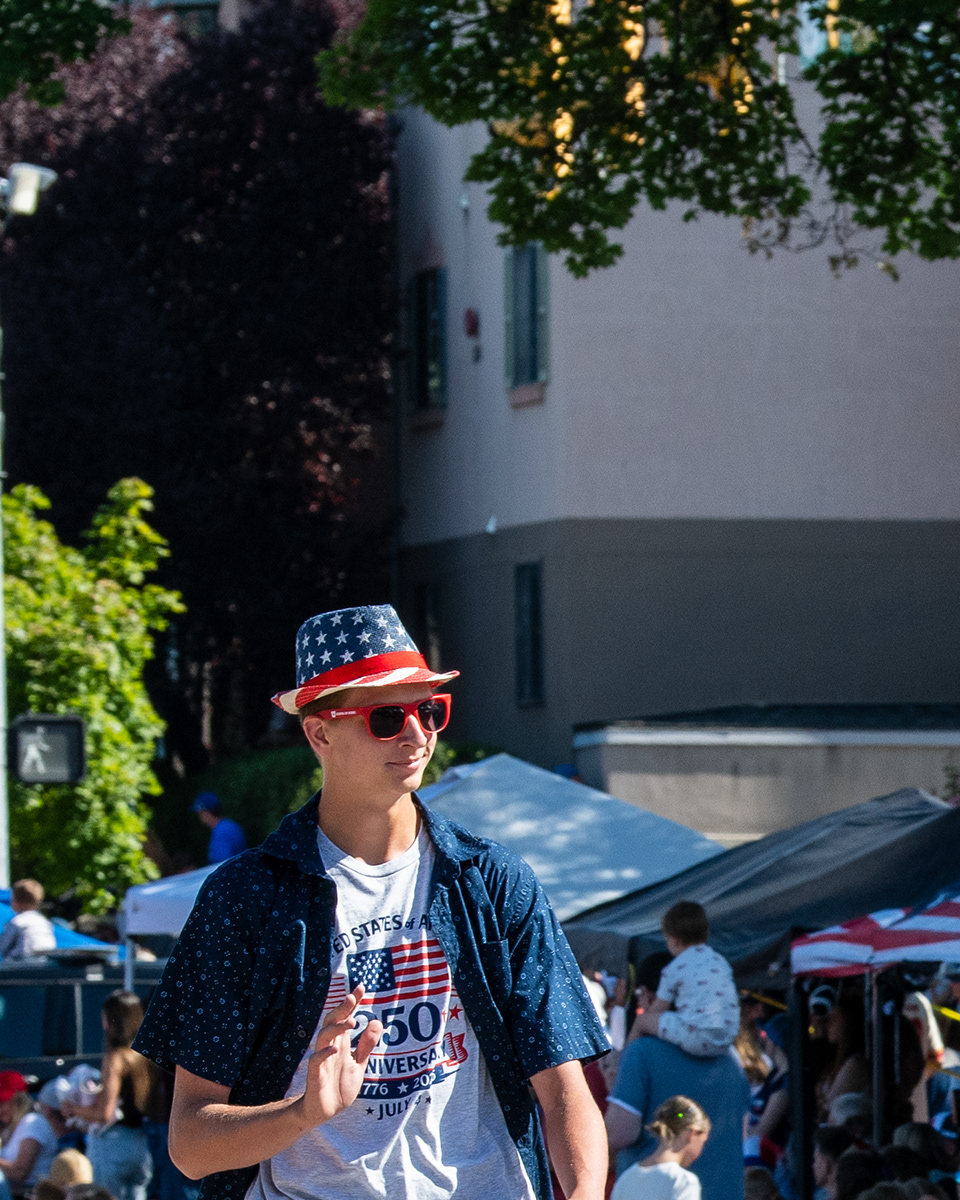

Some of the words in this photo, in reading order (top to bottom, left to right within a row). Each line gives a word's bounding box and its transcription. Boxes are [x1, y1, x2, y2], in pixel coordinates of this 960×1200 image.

[351, 914, 401, 942] STATES
[405, 917, 416, 930] of
[361, 1082, 389, 1096] 776
[377, 1096, 412, 1120] JULY
